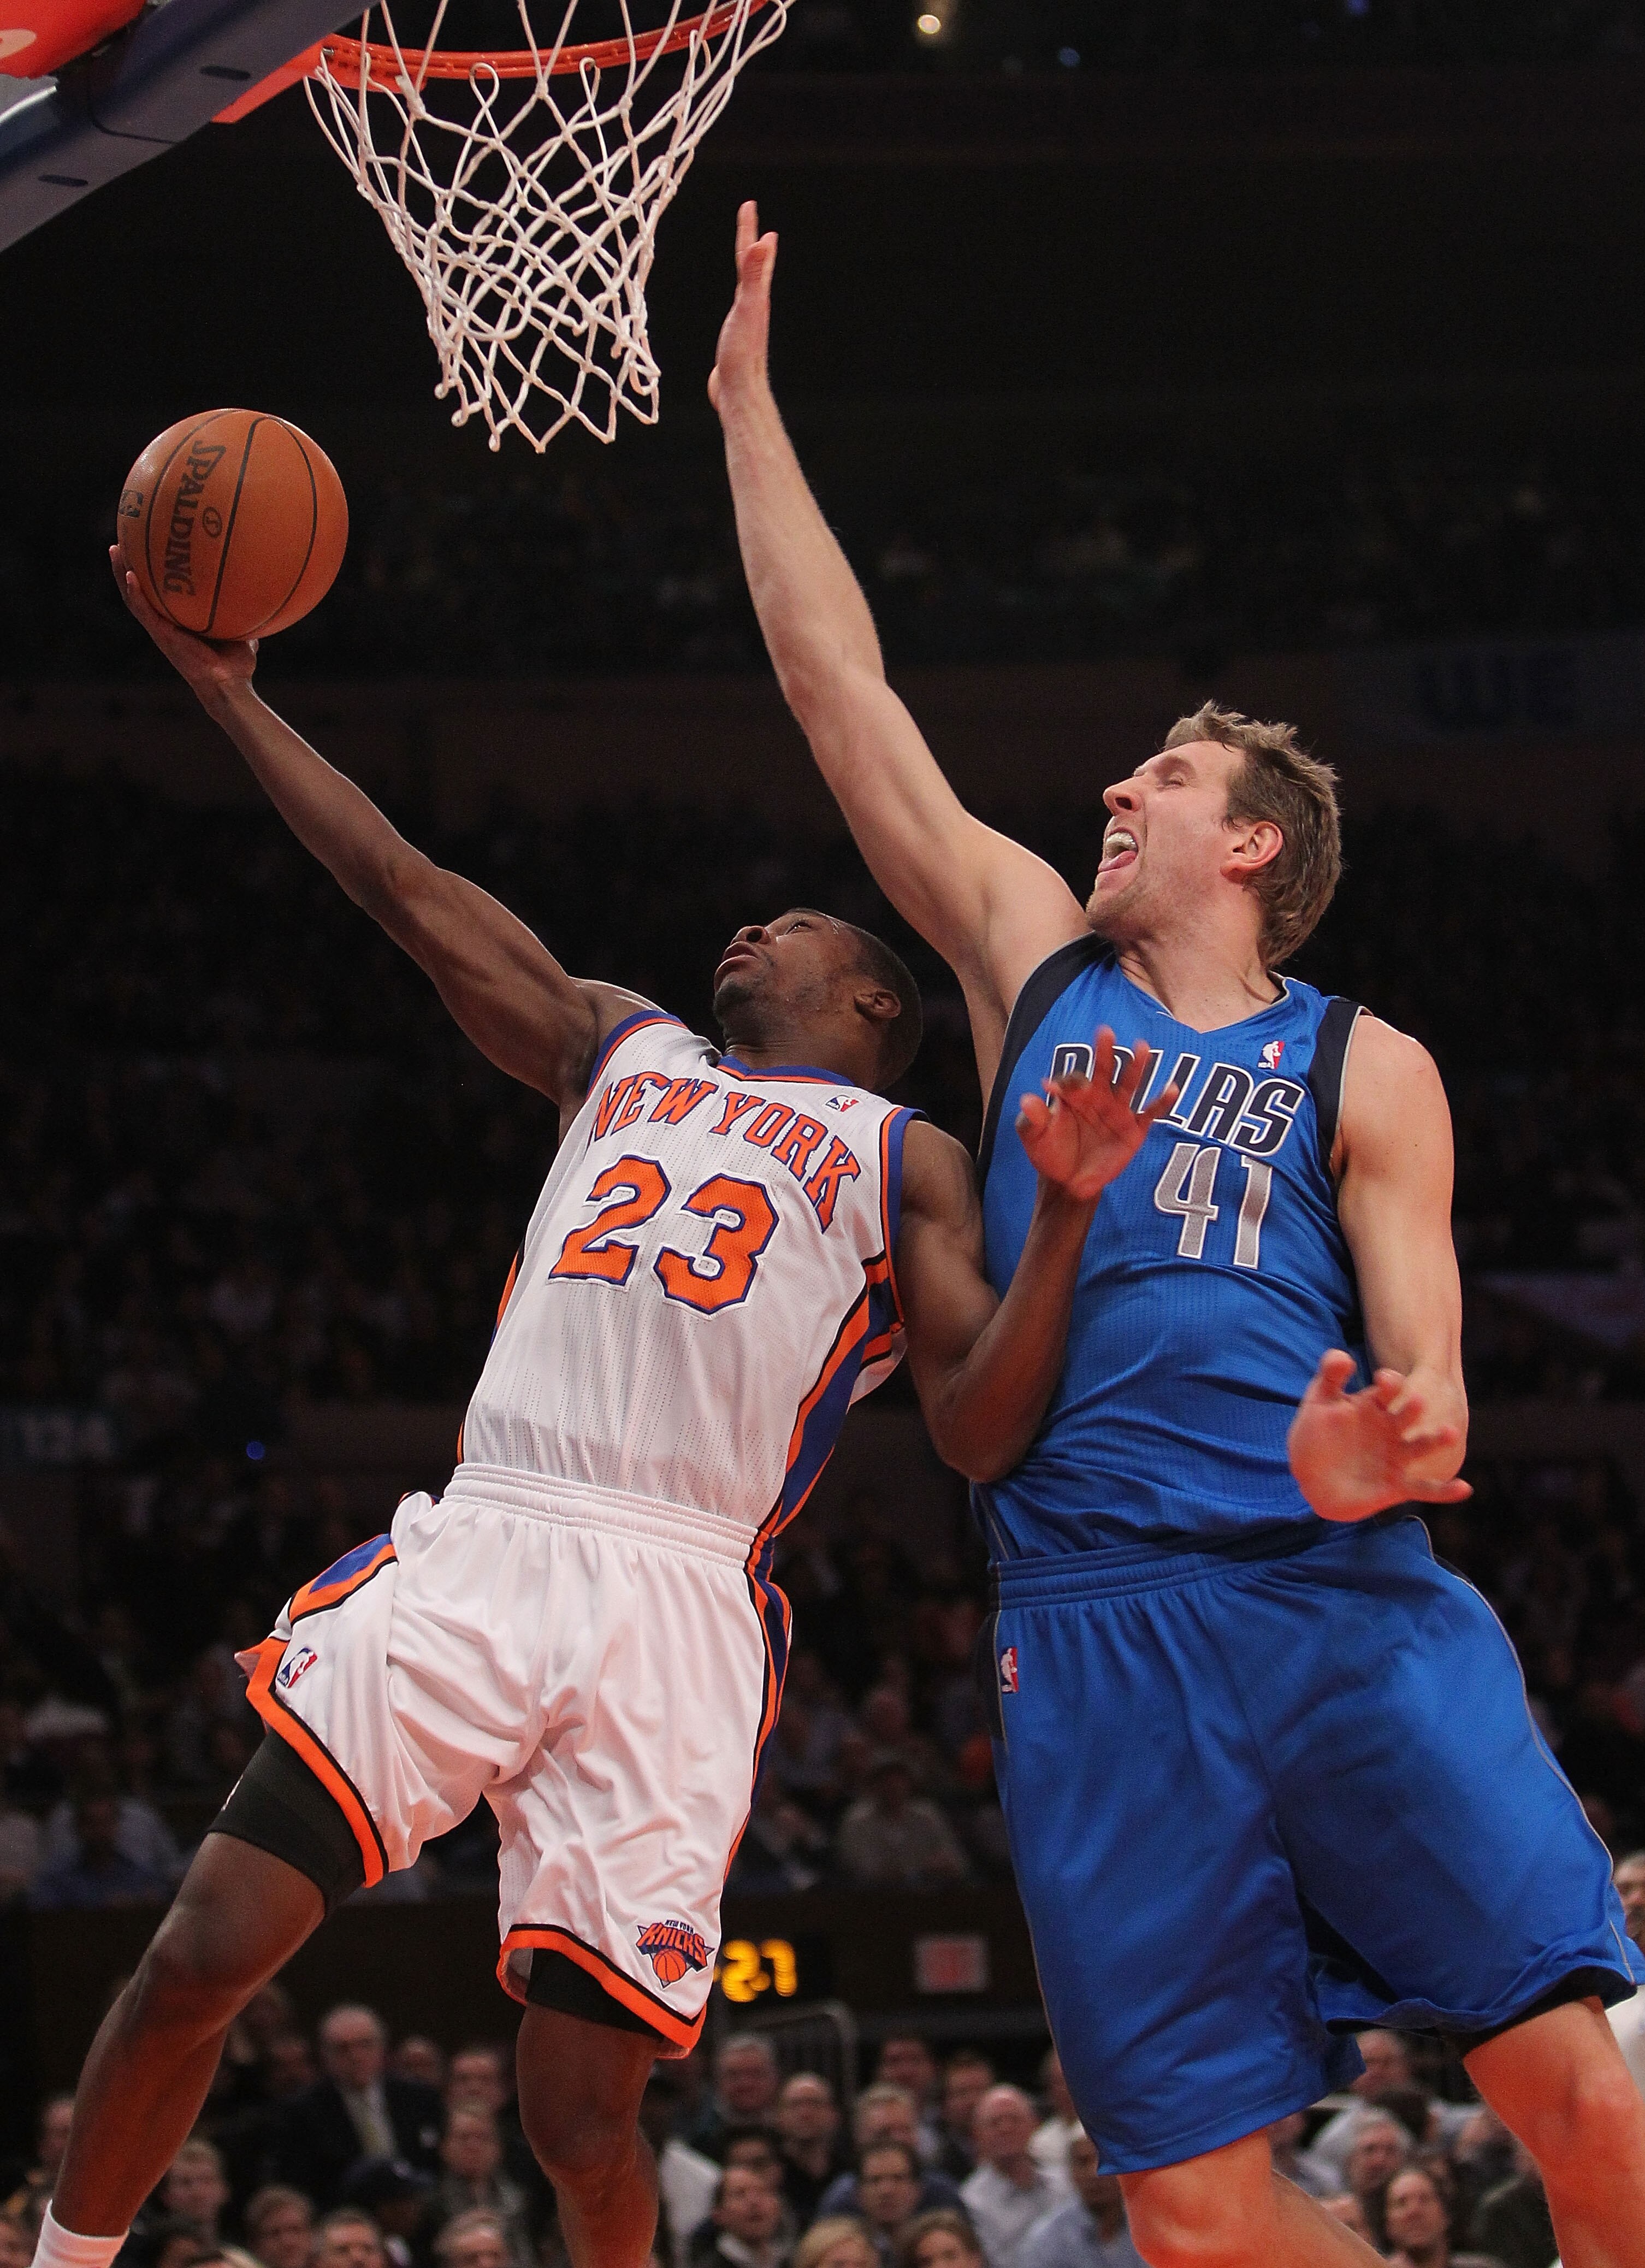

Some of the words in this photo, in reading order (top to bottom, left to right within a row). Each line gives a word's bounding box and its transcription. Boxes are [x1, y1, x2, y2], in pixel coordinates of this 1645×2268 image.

[165, 440, 227, 595] SPALDING
[594, 1071, 719, 1142] NEW
[708, 1091, 861, 1234] YORK
[1153, 1142, 1273, 1269] 41
[548, 1154, 780, 1315] 23
[636, 1922, 707, 1968] KNICKS
[680, 1922, 694, 1934] YORK
